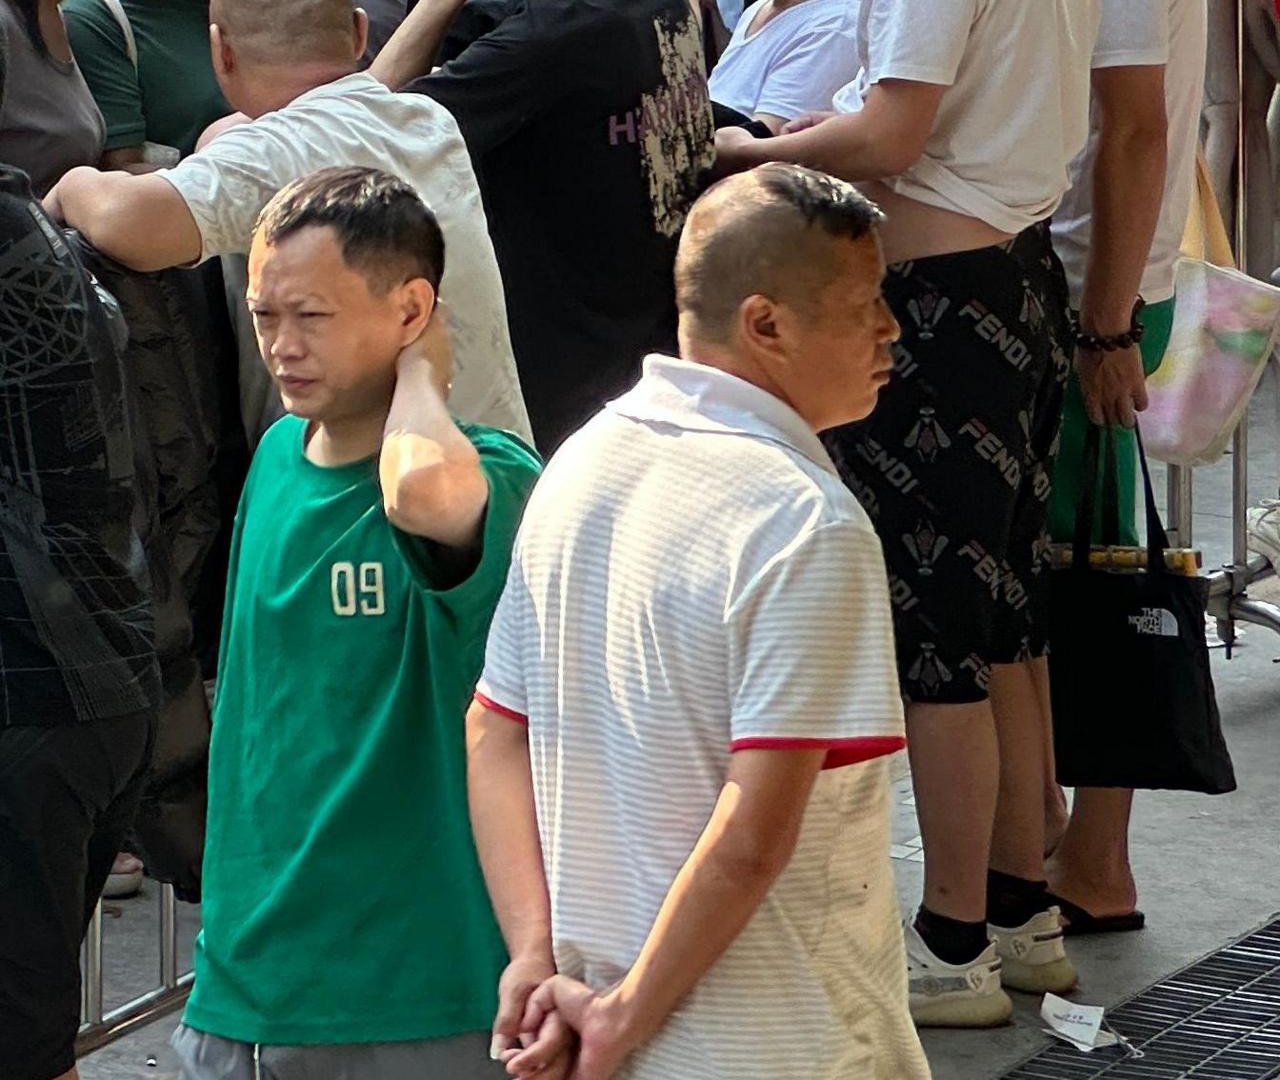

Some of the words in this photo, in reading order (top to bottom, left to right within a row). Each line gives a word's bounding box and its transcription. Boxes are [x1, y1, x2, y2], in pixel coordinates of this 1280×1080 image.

[958, 298, 1032, 371] FENDI
[331, 561, 385, 616] 09
[1141, 607, 1161, 617] THE
[1128, 615, 1161, 626] NORTH
[1137, 624, 1161, 635] FACE
